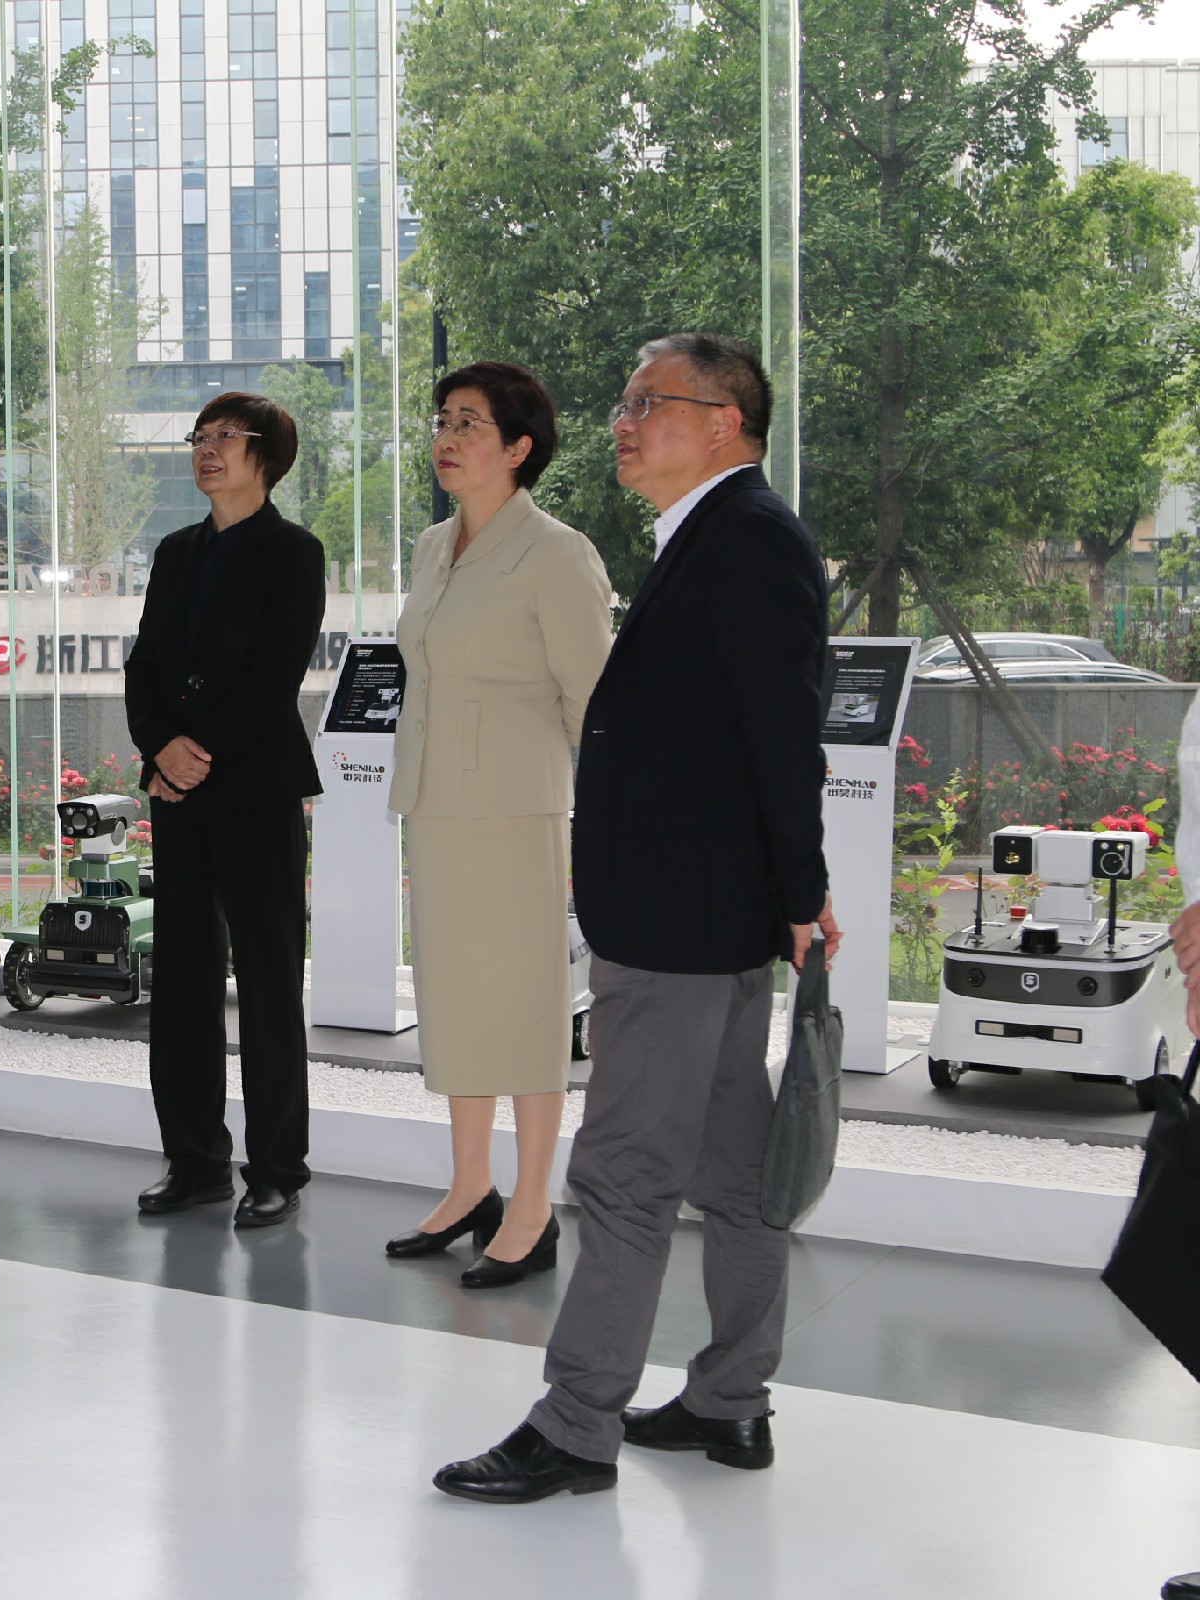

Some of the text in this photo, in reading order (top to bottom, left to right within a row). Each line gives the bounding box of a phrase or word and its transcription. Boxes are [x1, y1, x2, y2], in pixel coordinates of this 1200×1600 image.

[340, 763, 385, 773] SHENHAO
[824, 777, 877, 789] SHENHAO
[827, 788, 874, 800] 申昊科技
